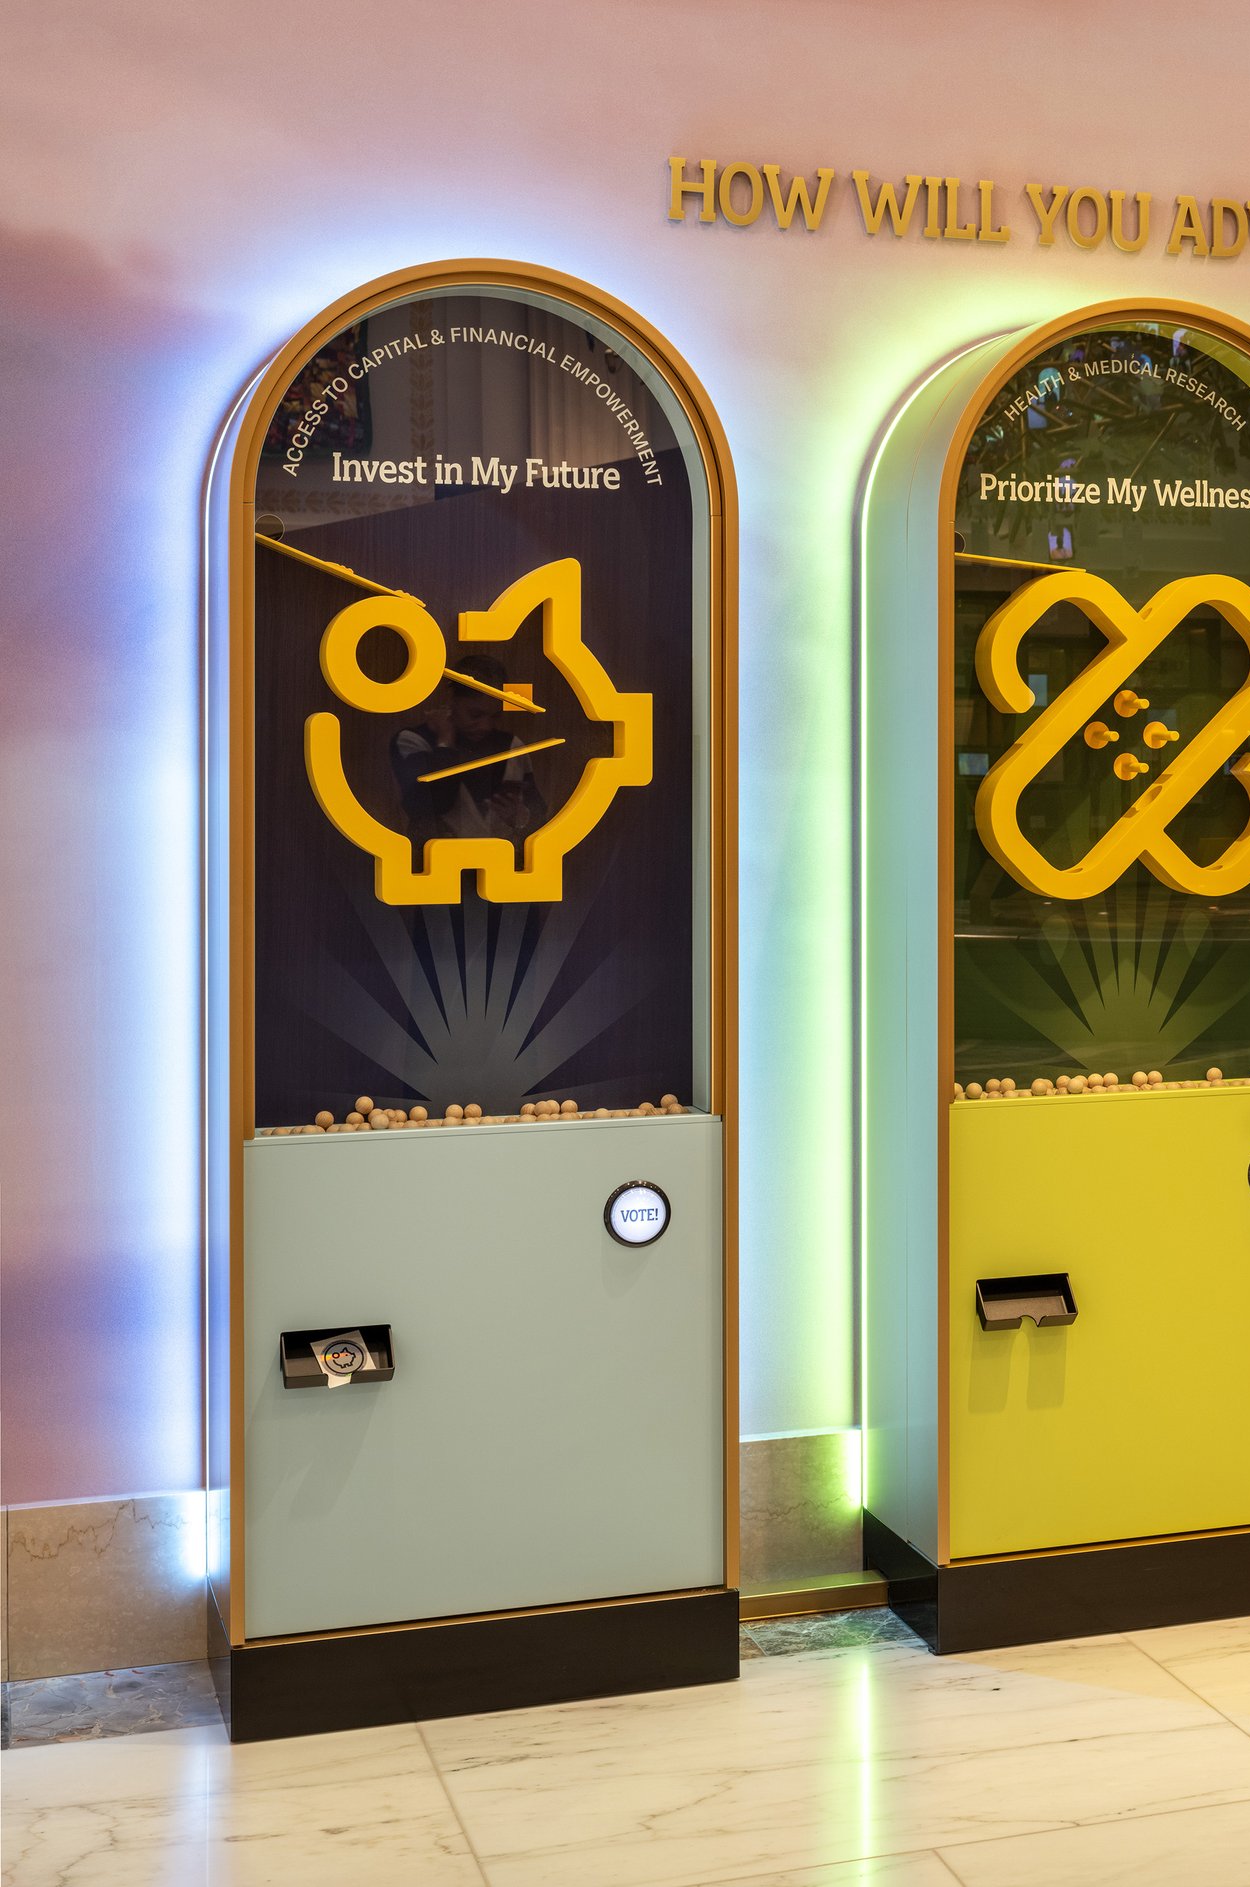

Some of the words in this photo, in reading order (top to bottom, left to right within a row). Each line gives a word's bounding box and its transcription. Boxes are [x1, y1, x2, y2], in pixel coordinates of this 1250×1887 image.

[667, 156, 835, 232] HOW
[852, 169, 1011, 243] WILL
[1025, 183, 1152, 252] YOU
[282, 399, 329, 477] ACCESS
[322, 376, 349, 403] TO
[348, 337, 428, 381] CAPITAL
[430, 329, 446, 346] &
[450, 326, 557, 364] FINANCIAL
[559, 355, 663, 487] EMPOWERMENT
[1003, 372, 1065, 422] HEALTH
[1067, 366, 1082, 382] &
[1084, 358, 1162, 380] MEDICAL
[1165, 367, 1247, 432] RESEARCH
[332, 451, 427, 485] Invest
[434, 454, 464, 486] in
[471, 456, 518, 494] My
[525, 458, 621, 490] Future
[979, 472, 1101, 504] Prioritize
[1107, 477, 1147, 512] My
[620, 1207, 659, 1223] VOTE!
